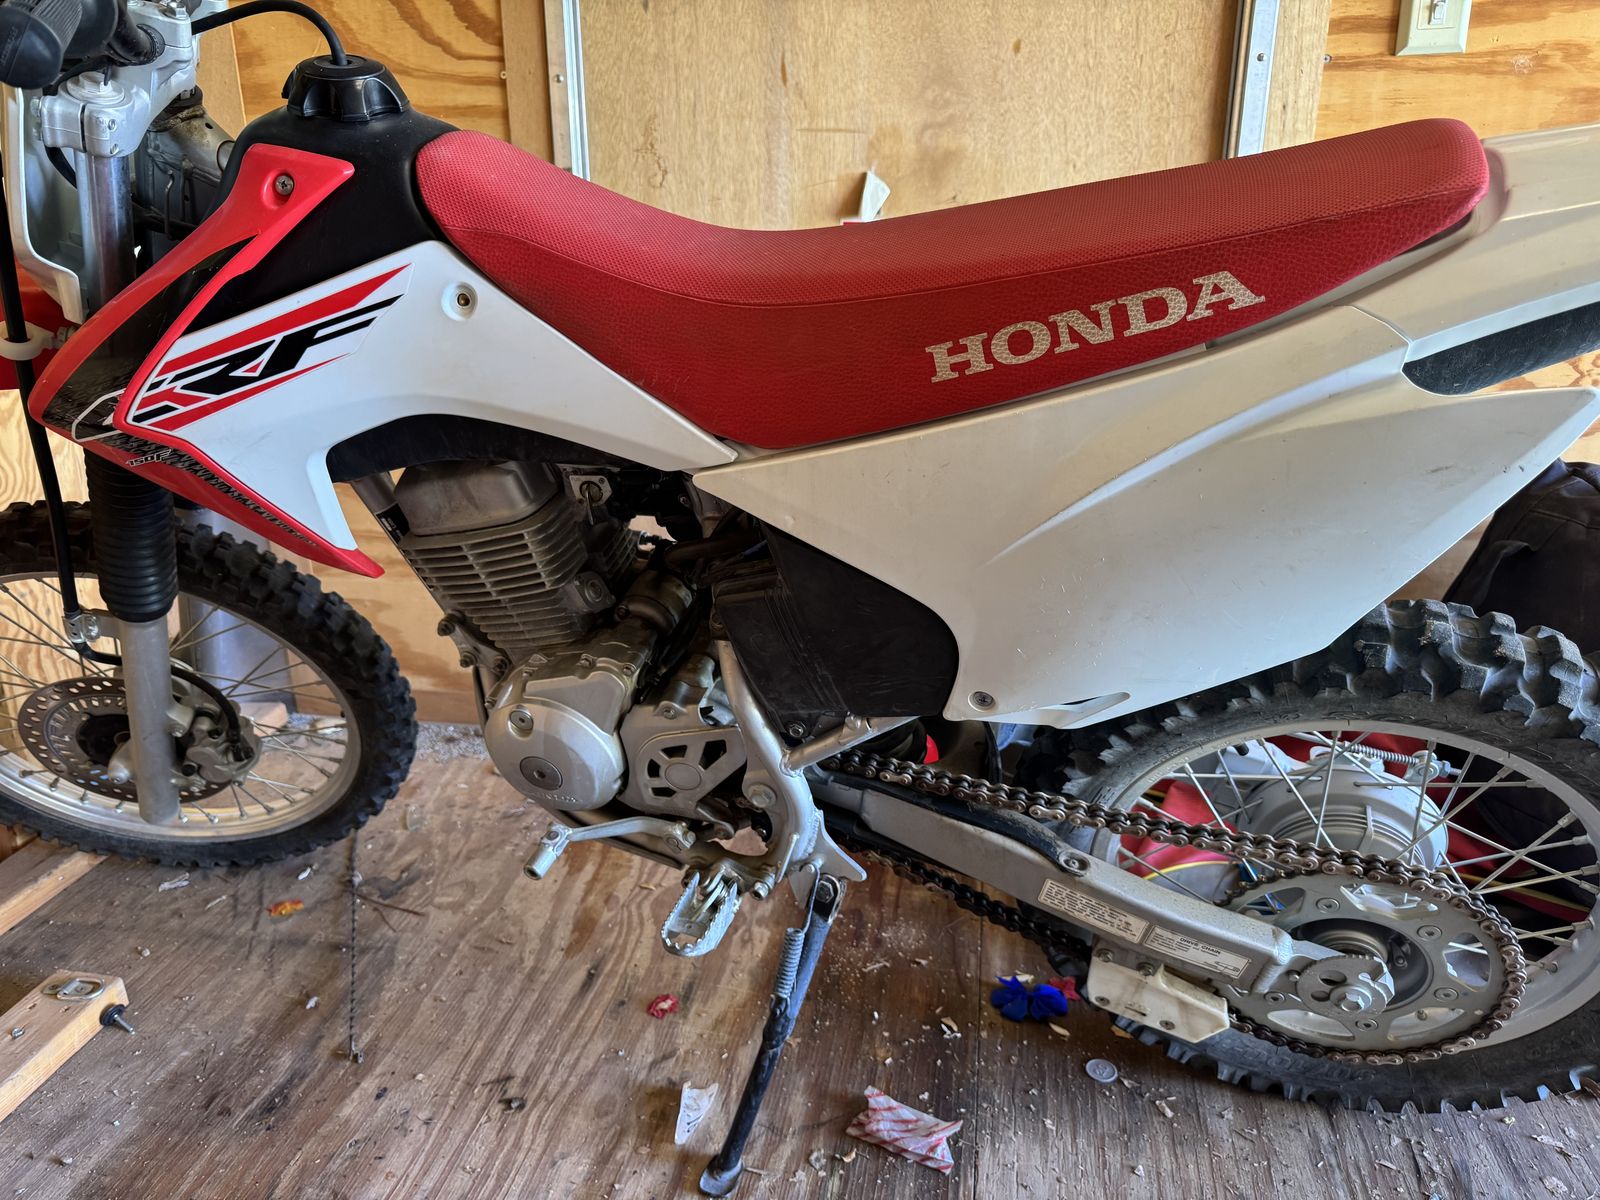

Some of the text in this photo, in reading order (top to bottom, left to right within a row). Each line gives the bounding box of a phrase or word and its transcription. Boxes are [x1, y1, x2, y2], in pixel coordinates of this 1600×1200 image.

[925, 271, 1265, 383] HONDA
[1179, 937, 1221, 955] DRIVE CHAIN
